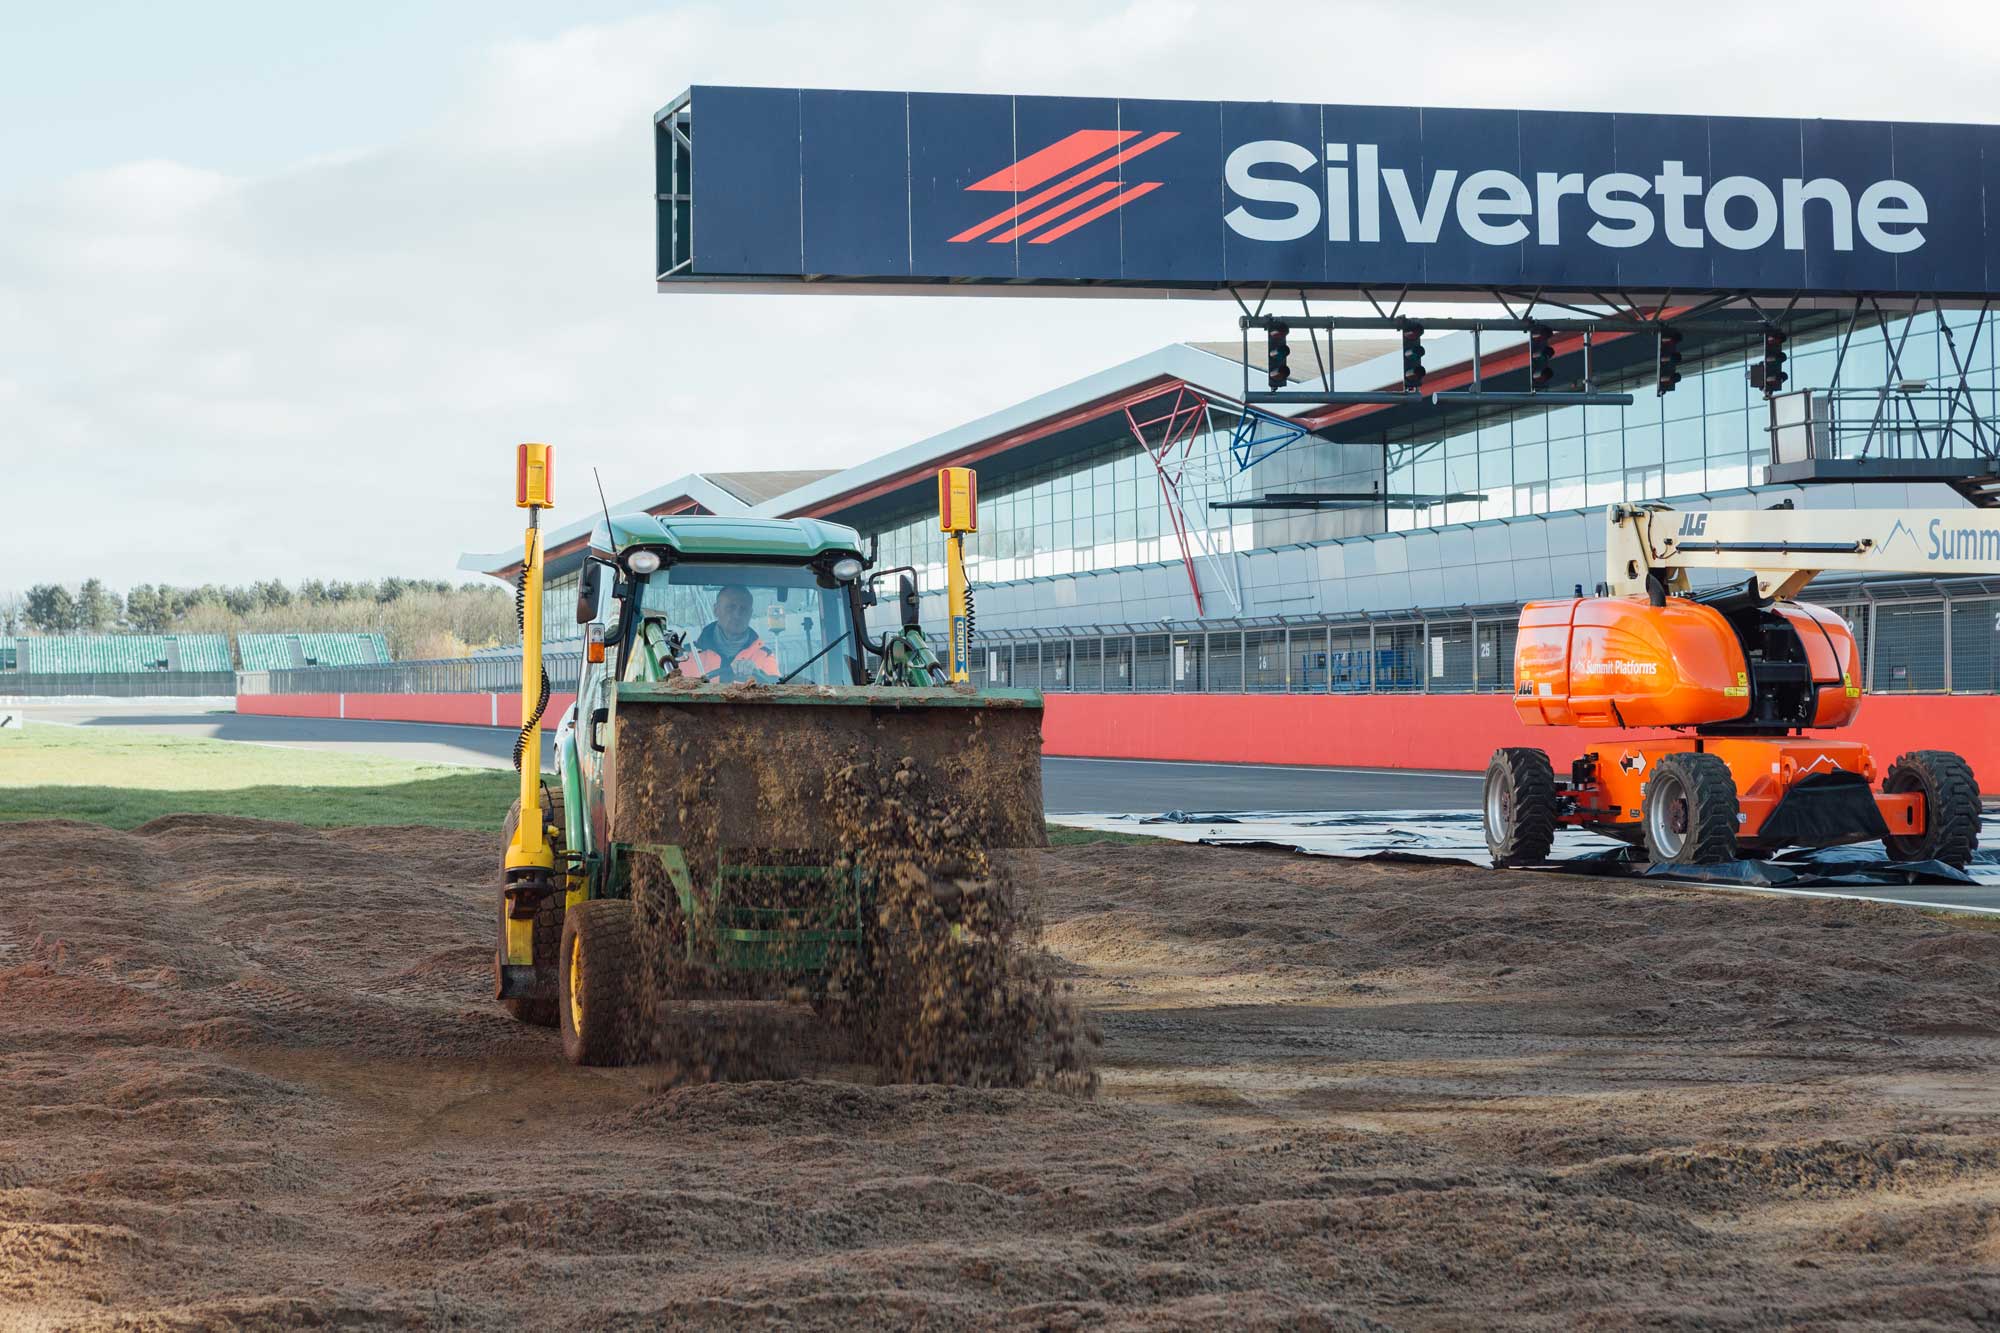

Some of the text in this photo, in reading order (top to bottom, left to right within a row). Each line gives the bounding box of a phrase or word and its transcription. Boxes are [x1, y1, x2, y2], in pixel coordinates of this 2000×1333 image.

[1224, 140, 1928, 254] Silverstone
[1678, 513, 1708, 537] JLG
[1928, 518, 2000, 560] Summ
[957, 620, 965, 662] GUIDED
[1481, 642, 1490, 657] 25
[1586, 659, 1657, 675] Summit Platforms
[1518, 680, 1533, 695] JLG
